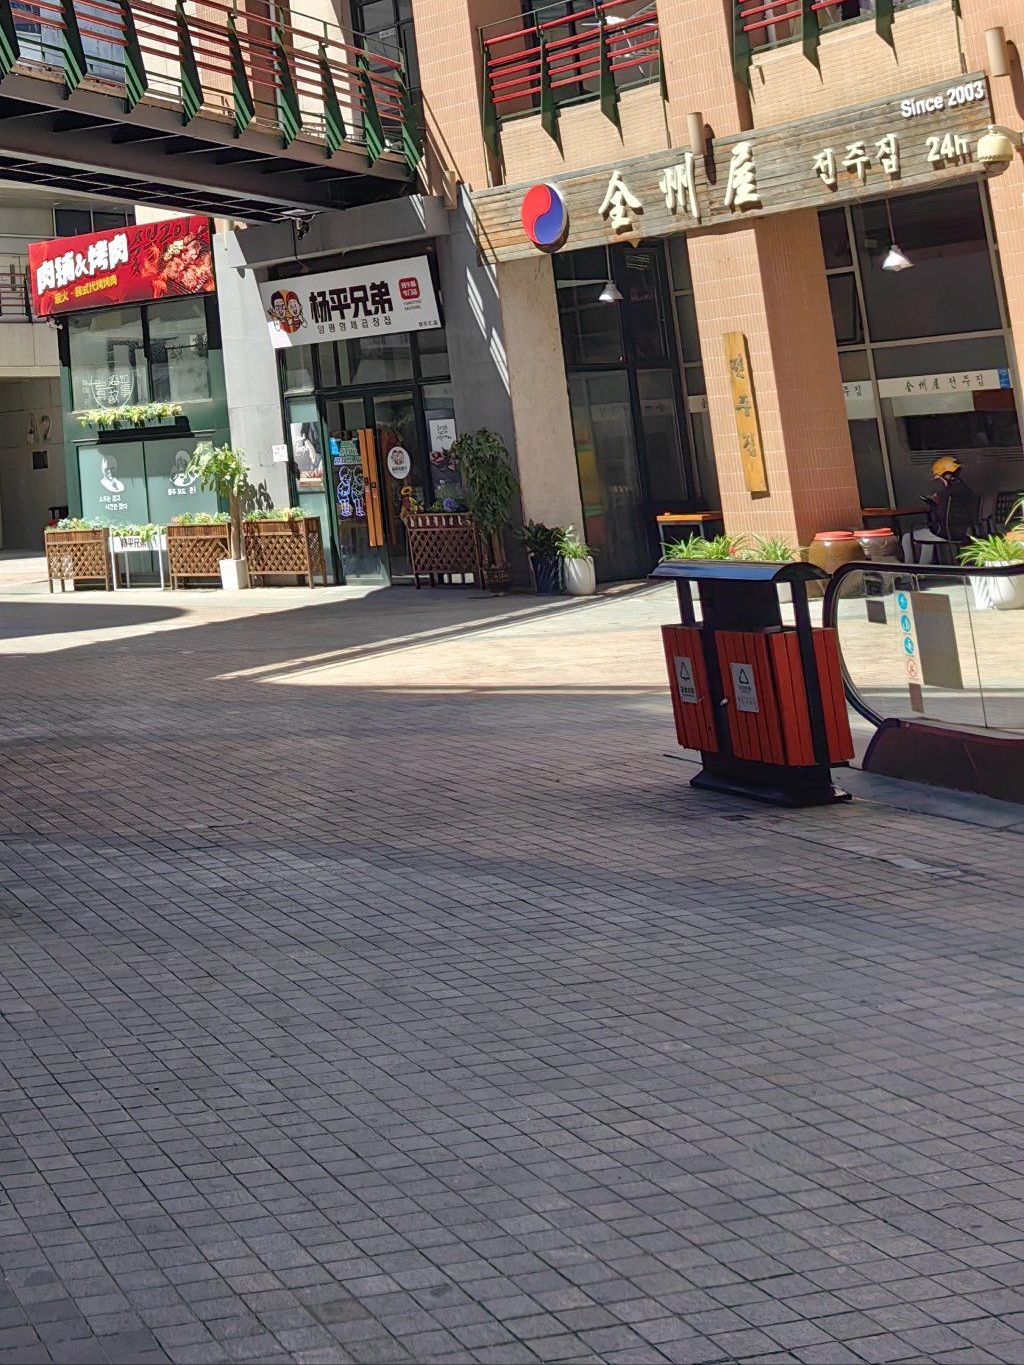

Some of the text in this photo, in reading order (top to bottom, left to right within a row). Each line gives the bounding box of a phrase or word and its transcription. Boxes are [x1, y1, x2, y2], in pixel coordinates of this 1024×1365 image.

[901, 81, 984, 118] Since 2003
[598, 133, 970, 230] 全州屋 전주집 24h
[37, 233, 129, 295] 肉铺&烤肉
[309, 281, 394, 324] 杨平兄弟
